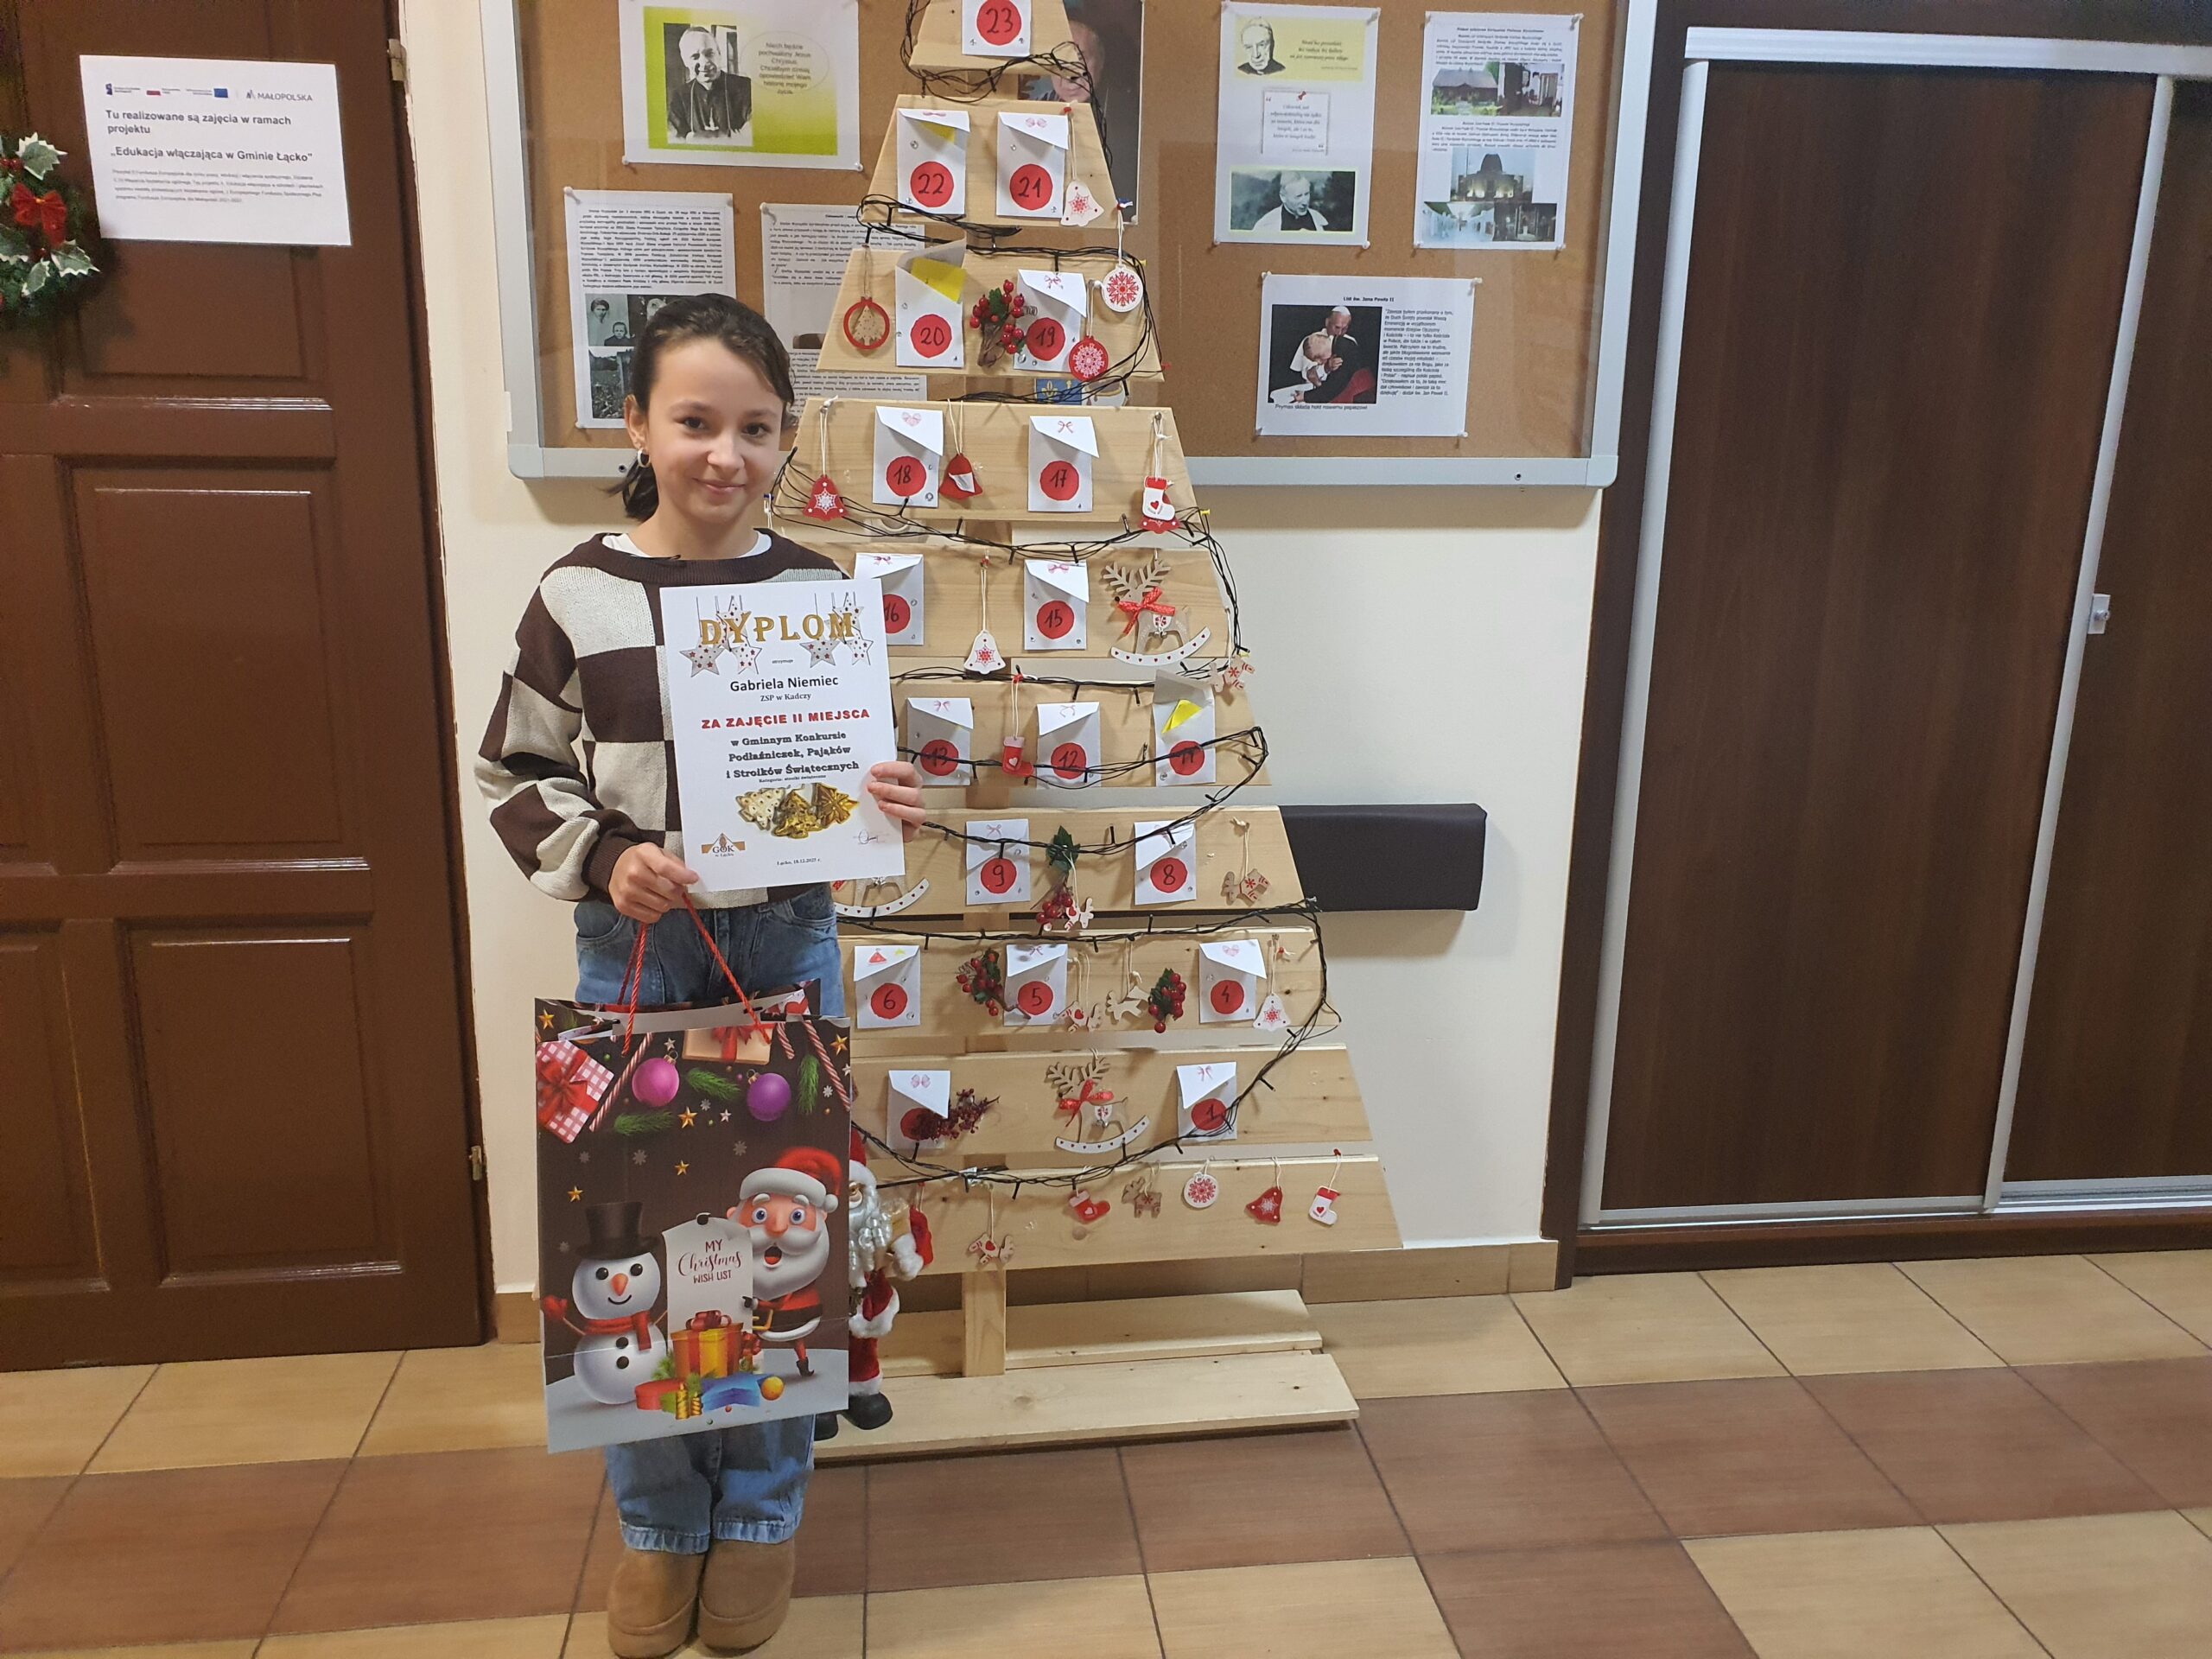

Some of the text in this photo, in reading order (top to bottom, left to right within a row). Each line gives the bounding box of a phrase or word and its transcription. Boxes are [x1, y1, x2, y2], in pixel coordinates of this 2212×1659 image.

[986, 8, 1014, 34] 23
[257, 92, 313, 101] MAŁOPOLSKA
[105, 110, 119, 119] Tu
[123, 110, 184, 121] realizowane
[188, 114, 200, 124] są
[202, 113, 238, 124] zajęcia
[252, 115, 291, 125] ramach
[107, 124, 151, 135] projektu
[166, 149, 224, 161] włączająca
[237, 150, 274, 161] Gminie
[918, 174, 944, 194] 22
[1018, 177, 1040, 198] 21
[920, 327, 944, 346] 20
[1036, 326, 1054, 347] 19
[893, 465, 911, 486] 18
[1050, 469, 1067, 488] 17
[884, 601, 899, 622] 16
[1044, 608, 1064, 628] 15
[700, 611, 855, 645] DYPLOM
[730, 676, 839, 692] Gabriela Niemiec
[760, 694, 774, 702] ZSP
[785, 692, 811, 702] Kadczy
[702, 709, 870, 729] ZA ZAJĘCIE II MIEJSCA
[741, 735, 792, 747] Gminnym
[795, 731, 847, 742] Konkursie
[807, 745, 851, 758] Pająków
[1058, 751, 1077, 770] 12
[734, 766, 783, 779] Stroików
[785, 760, 860, 774] Świątecznych
[712, 845, 734, 854] GOK
[992, 864, 1004, 887] 9
[1163, 864, 1176, 886] 8
[883, 989, 896, 1010] 6
[1031, 987, 1042, 1007] 5
[1221, 985, 1230, 1003] 4
[705, 1239, 723, 1253] MY
[678, 1251, 741, 1277] Christmas
[693, 1269, 732, 1284] WISH LIST
